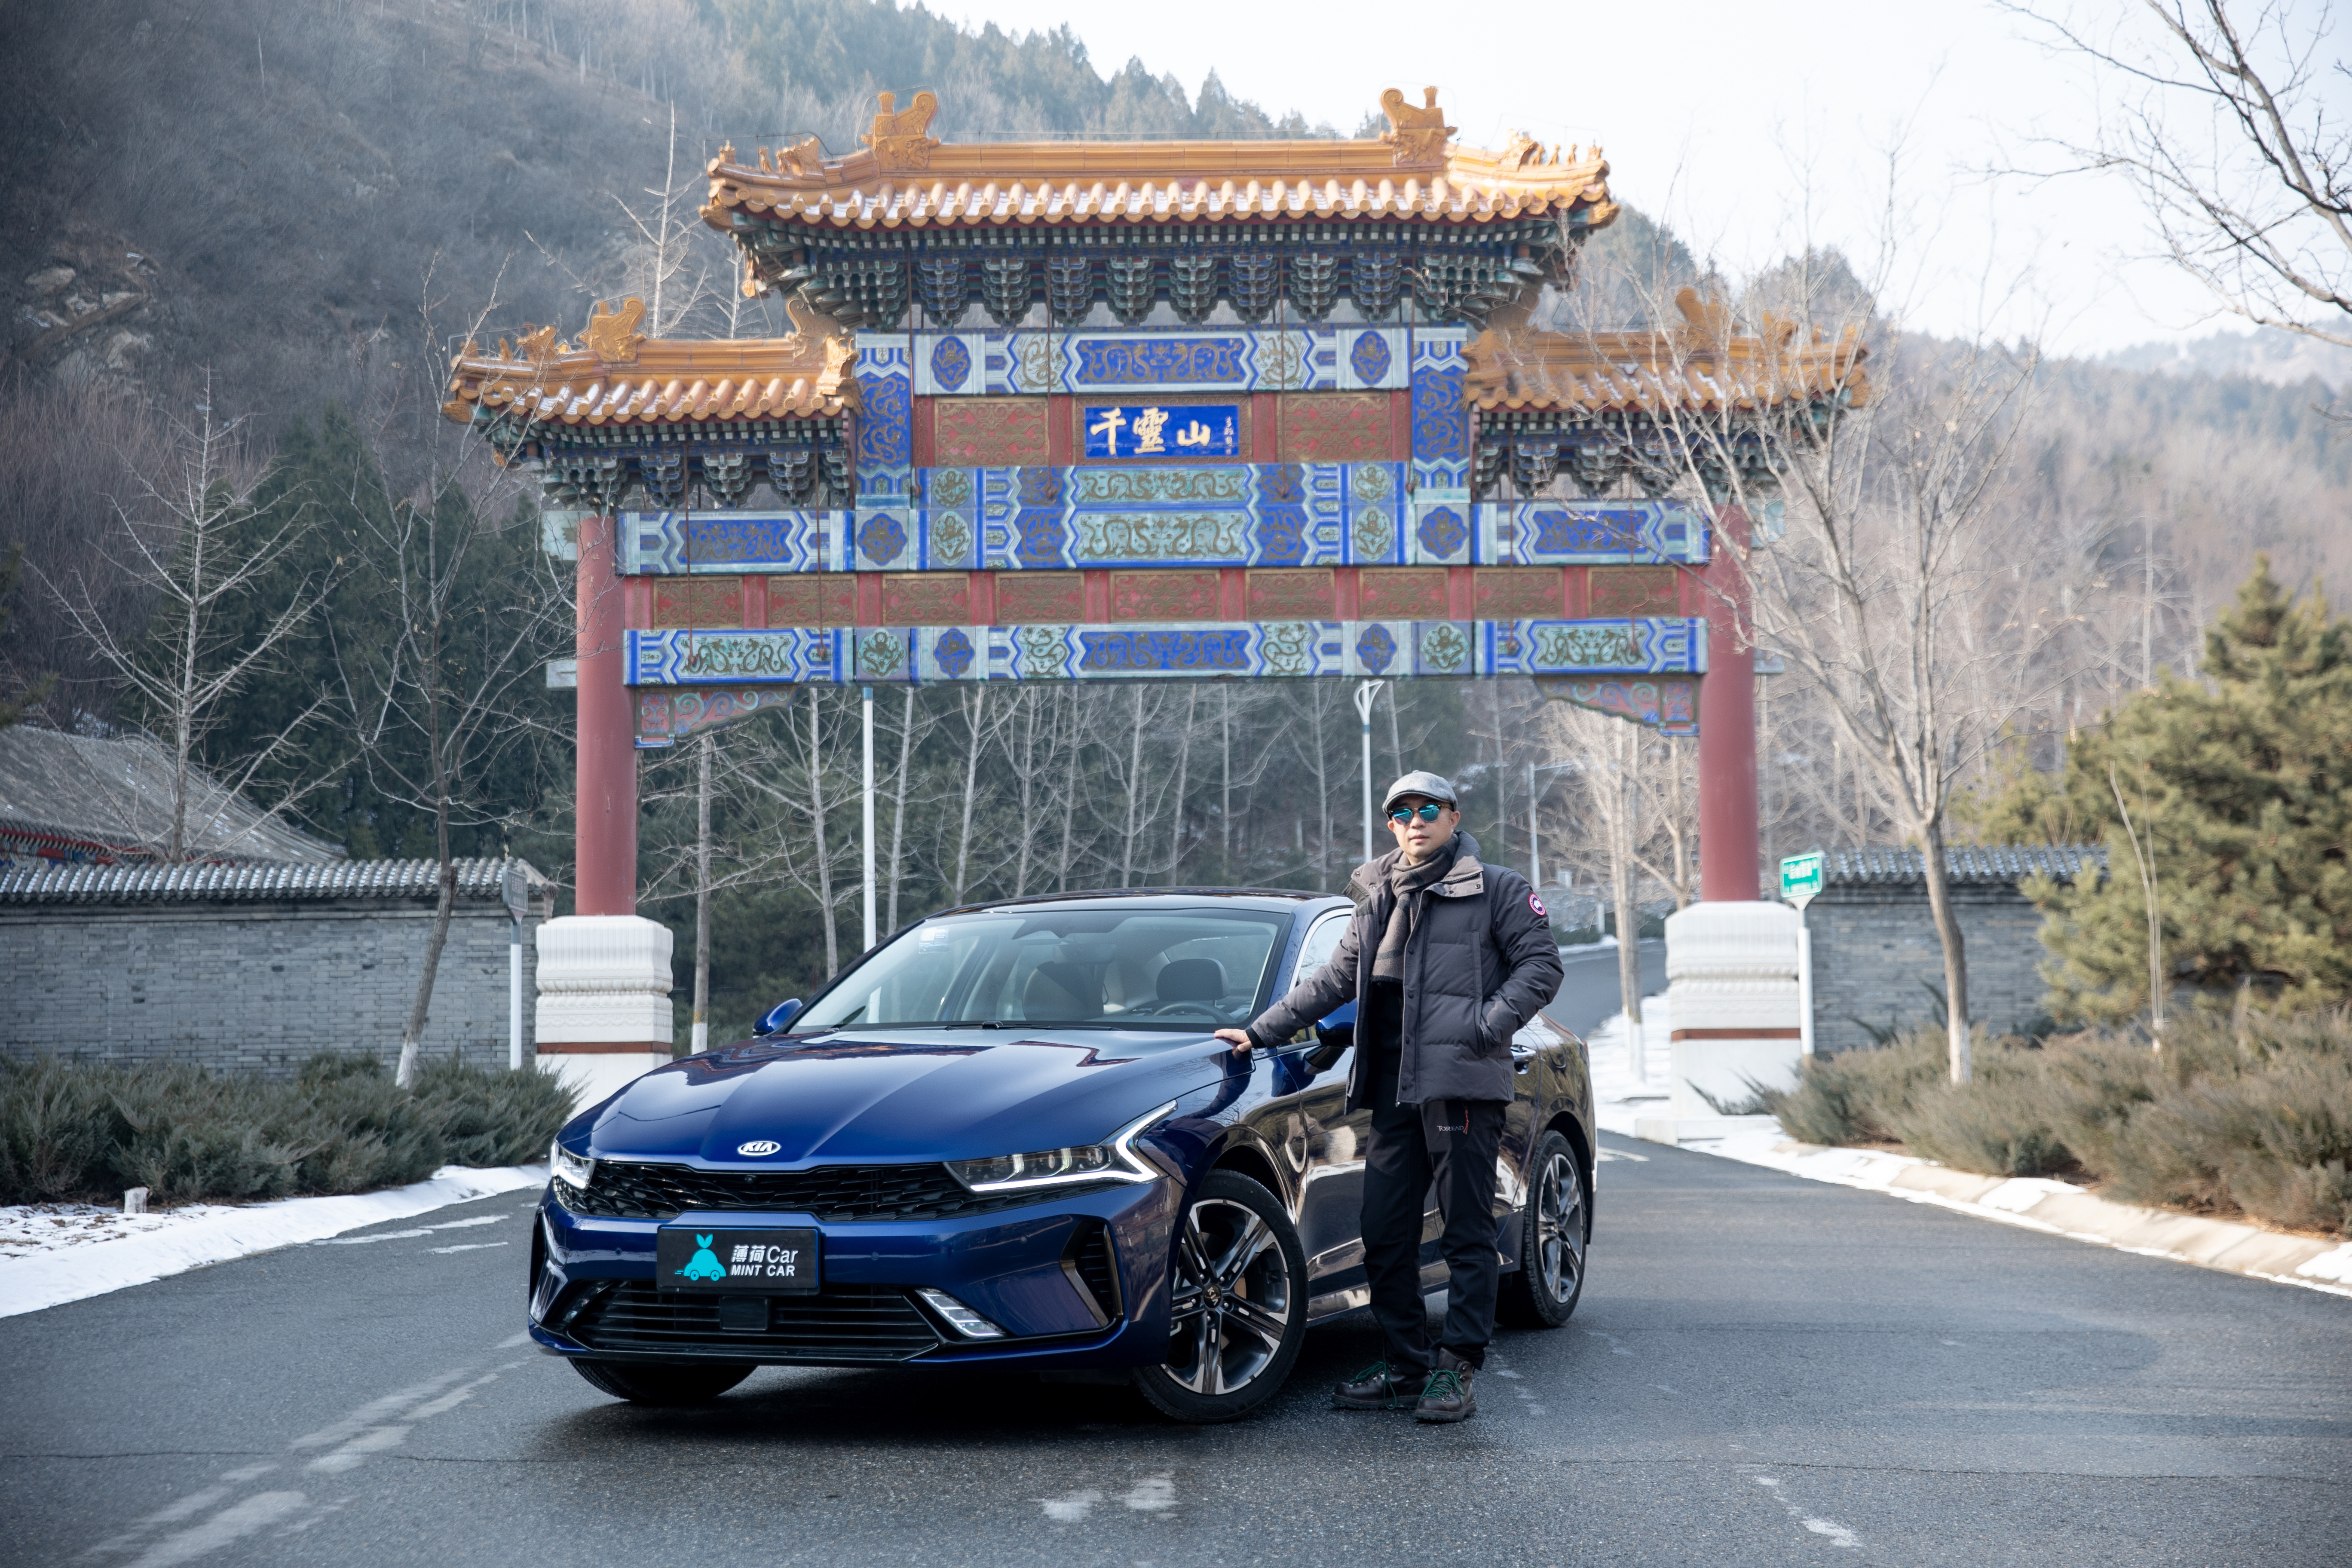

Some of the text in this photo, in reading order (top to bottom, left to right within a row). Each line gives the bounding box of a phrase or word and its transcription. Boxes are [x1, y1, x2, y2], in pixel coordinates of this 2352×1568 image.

[743, 1142, 773, 1152] KIA
[731, 1265, 795, 1277] MINT CAR
[1207, 1286, 1219, 1306] KIA
